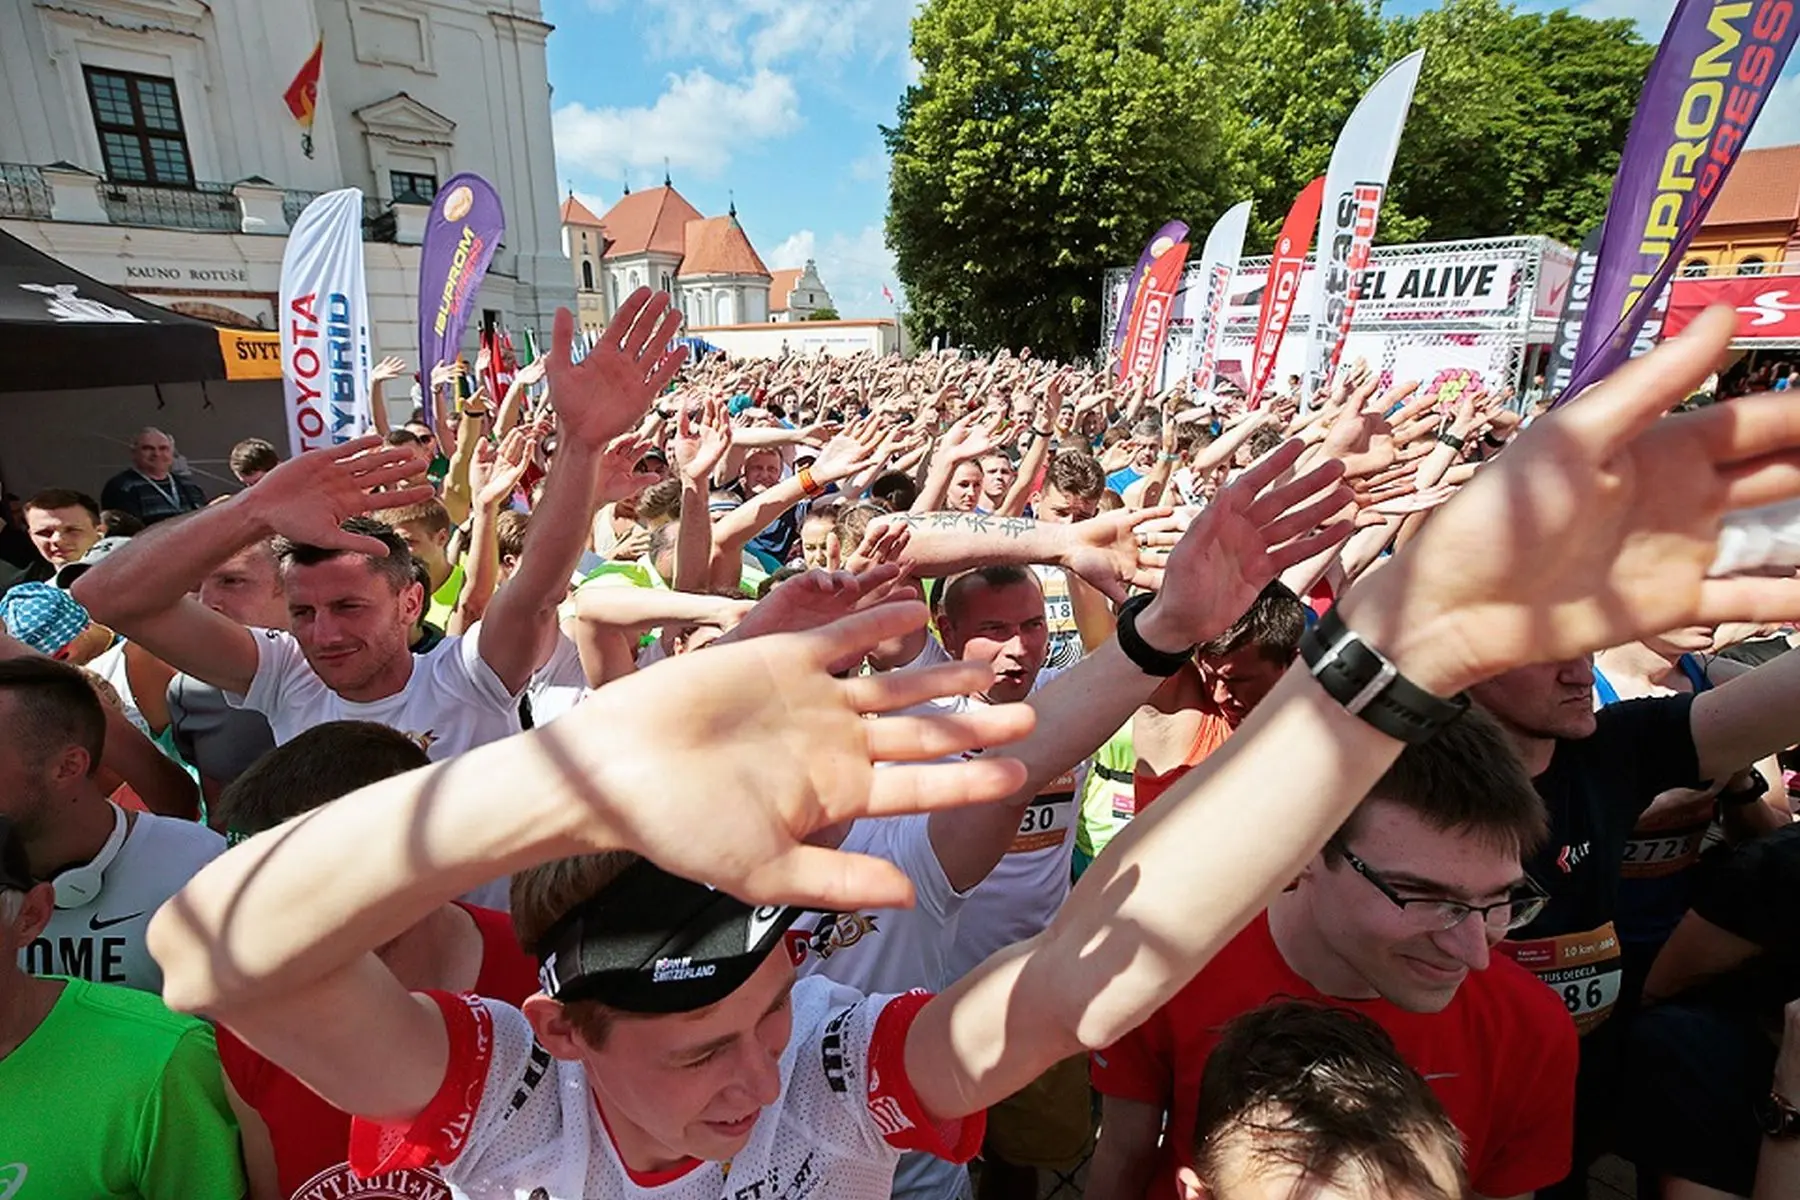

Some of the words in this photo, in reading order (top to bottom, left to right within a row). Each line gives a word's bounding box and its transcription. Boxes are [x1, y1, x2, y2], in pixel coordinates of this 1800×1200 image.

[126, 266, 181, 280] KAUNO
[434, 225, 475, 337] IBUPROM
[1397, 264, 1498, 299] ALIVE
[291, 292, 324, 452] TOYOTA
[1019, 806, 1054, 832] 30
[653, 965, 716, 982] SWITZERLAND
[1563, 978, 1603, 1012] 86
